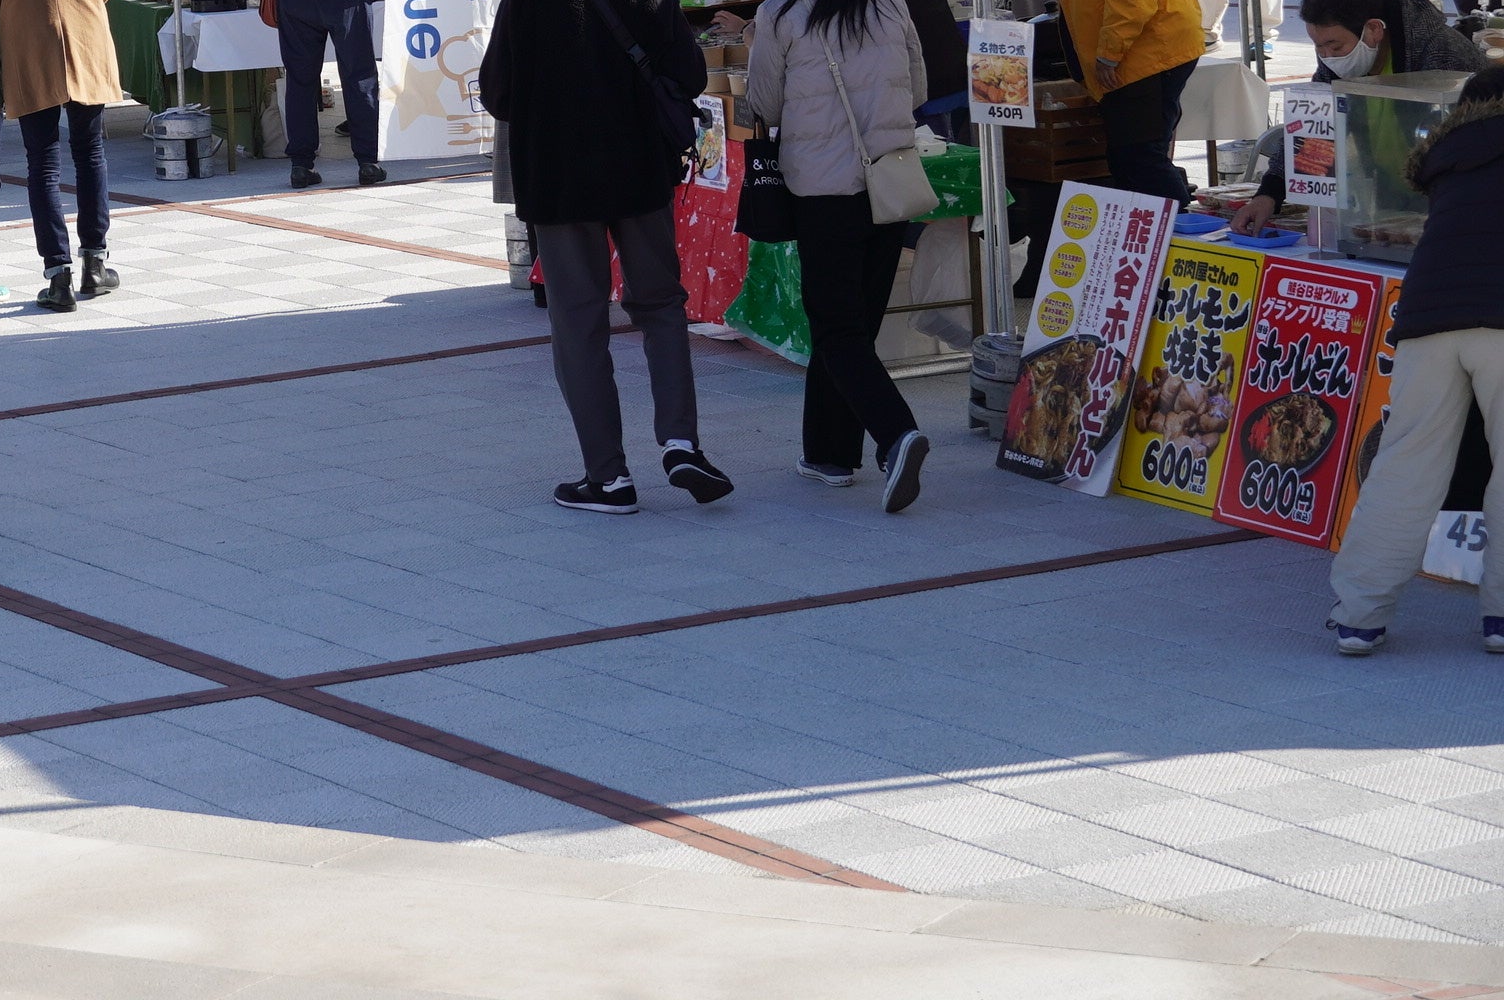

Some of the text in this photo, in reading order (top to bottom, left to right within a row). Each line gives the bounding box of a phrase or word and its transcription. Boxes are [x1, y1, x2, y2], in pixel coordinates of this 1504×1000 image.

[979, 42, 1026, 57] 名物もつ煮
[988, 106, 1023, 120] 450円
[1287, 99, 1331, 116] フランク
[1304, 119, 1336, 136] フルト
[752, 158, 763, 171] &
[1172, 257, 1239, 287] お肉屋さんの
[1151, 275, 1251, 333] ホルモン
[1286, 279, 1350, 305] 熊谷B級グルメ
[1261, 296, 1352, 335] グランプリ受賞
[1064, 206, 1155, 479] 熊谷ホルどん
[1162, 324, 1222, 386] 焼き
[1248, 327, 1356, 399] ホルどん
[1141, 438, 1208, 492] 600円
[1238, 458, 1316, 521] 600円
